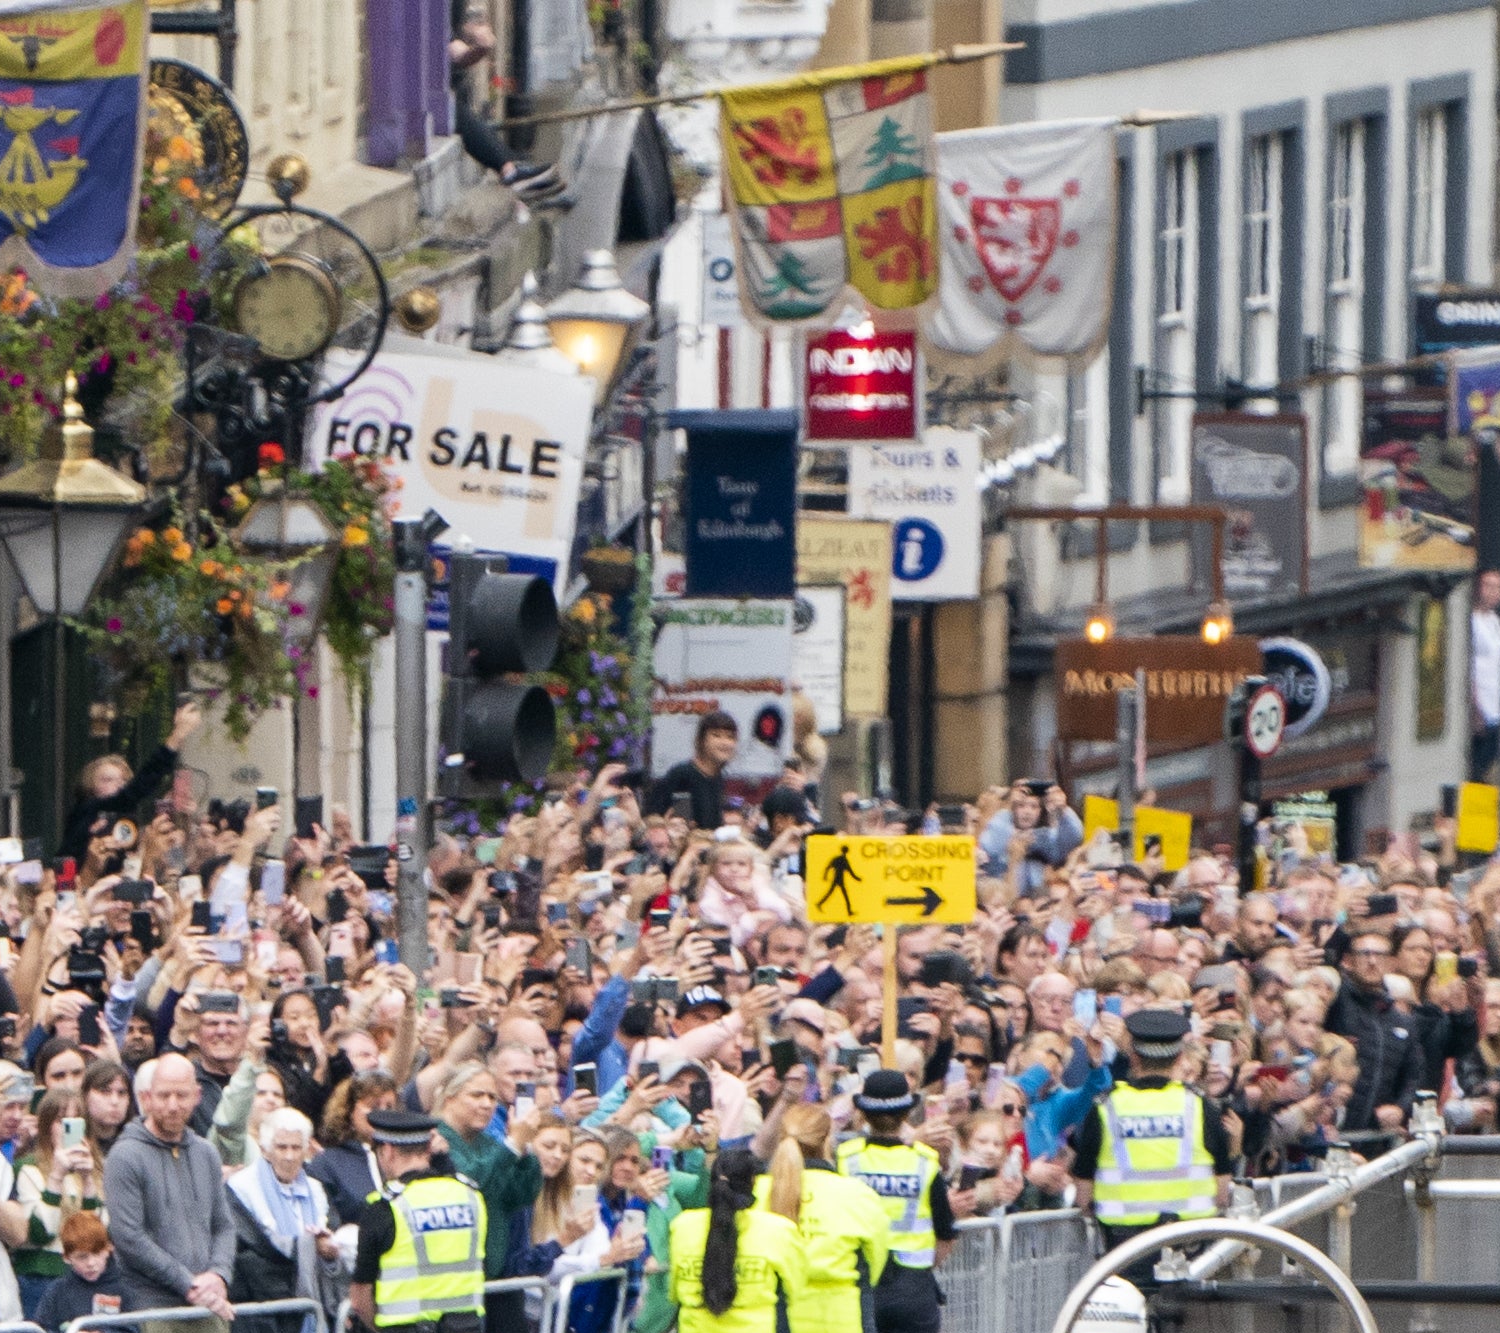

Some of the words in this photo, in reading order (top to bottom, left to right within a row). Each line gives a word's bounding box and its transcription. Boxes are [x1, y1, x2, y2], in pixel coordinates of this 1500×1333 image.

[810, 347, 913, 376] INDIAN
[327, 417, 413, 462] FOR
[429, 426, 562, 479] SALE
[1254, 704, 1278, 737] 20
[860, 841, 972, 860] CROSSING
[883, 864, 945, 882] POINT
[1121, 1115, 1184, 1137] POLICE
[416, 1205, 473, 1231] POLICE
